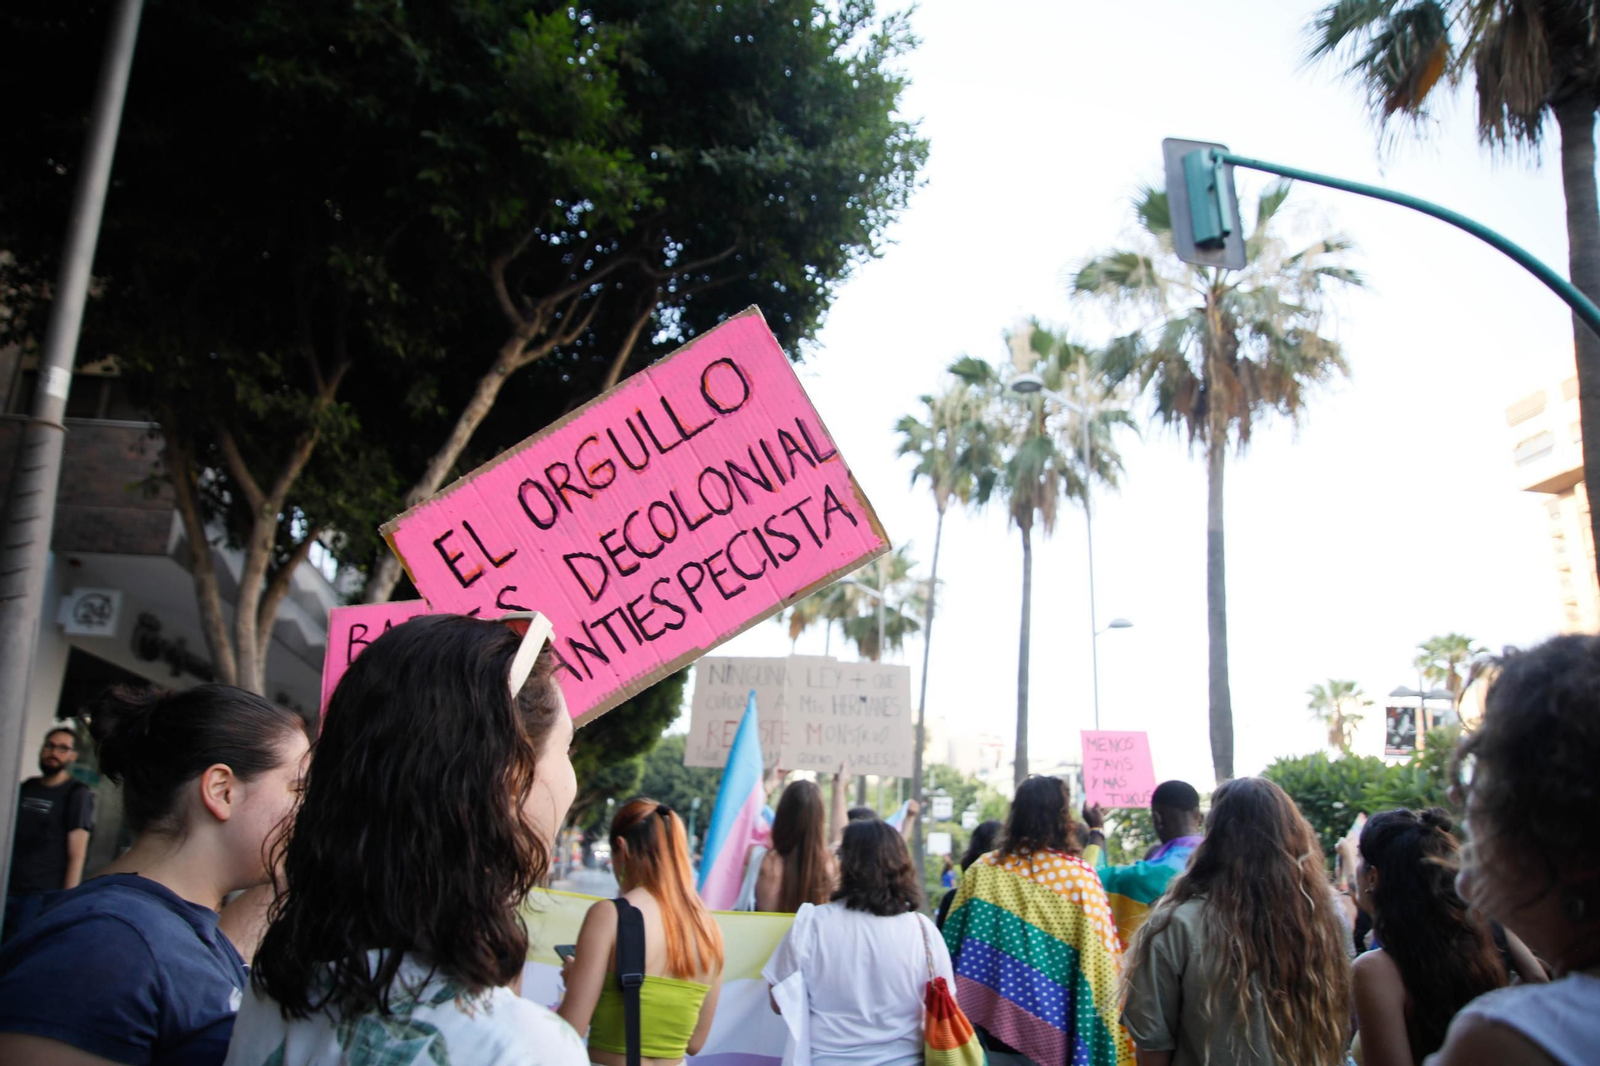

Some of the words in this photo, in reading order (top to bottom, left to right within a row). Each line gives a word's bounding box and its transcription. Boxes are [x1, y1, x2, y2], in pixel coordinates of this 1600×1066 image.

[433, 520, 518, 589] EL
[518, 356, 750, 530] ORGULLO
[563, 416, 838, 602] DECOLONIAL
[806, 666, 844, 690] LEY
[705, 692, 759, 711] CUIDA
[773, 692, 790, 710] A
[706, 719, 791, 749] RESTE
[1086, 736, 1134, 753] MENOS
[1091, 757, 1134, 772] JAVIS
[1091, 776, 1099, 789] Y
